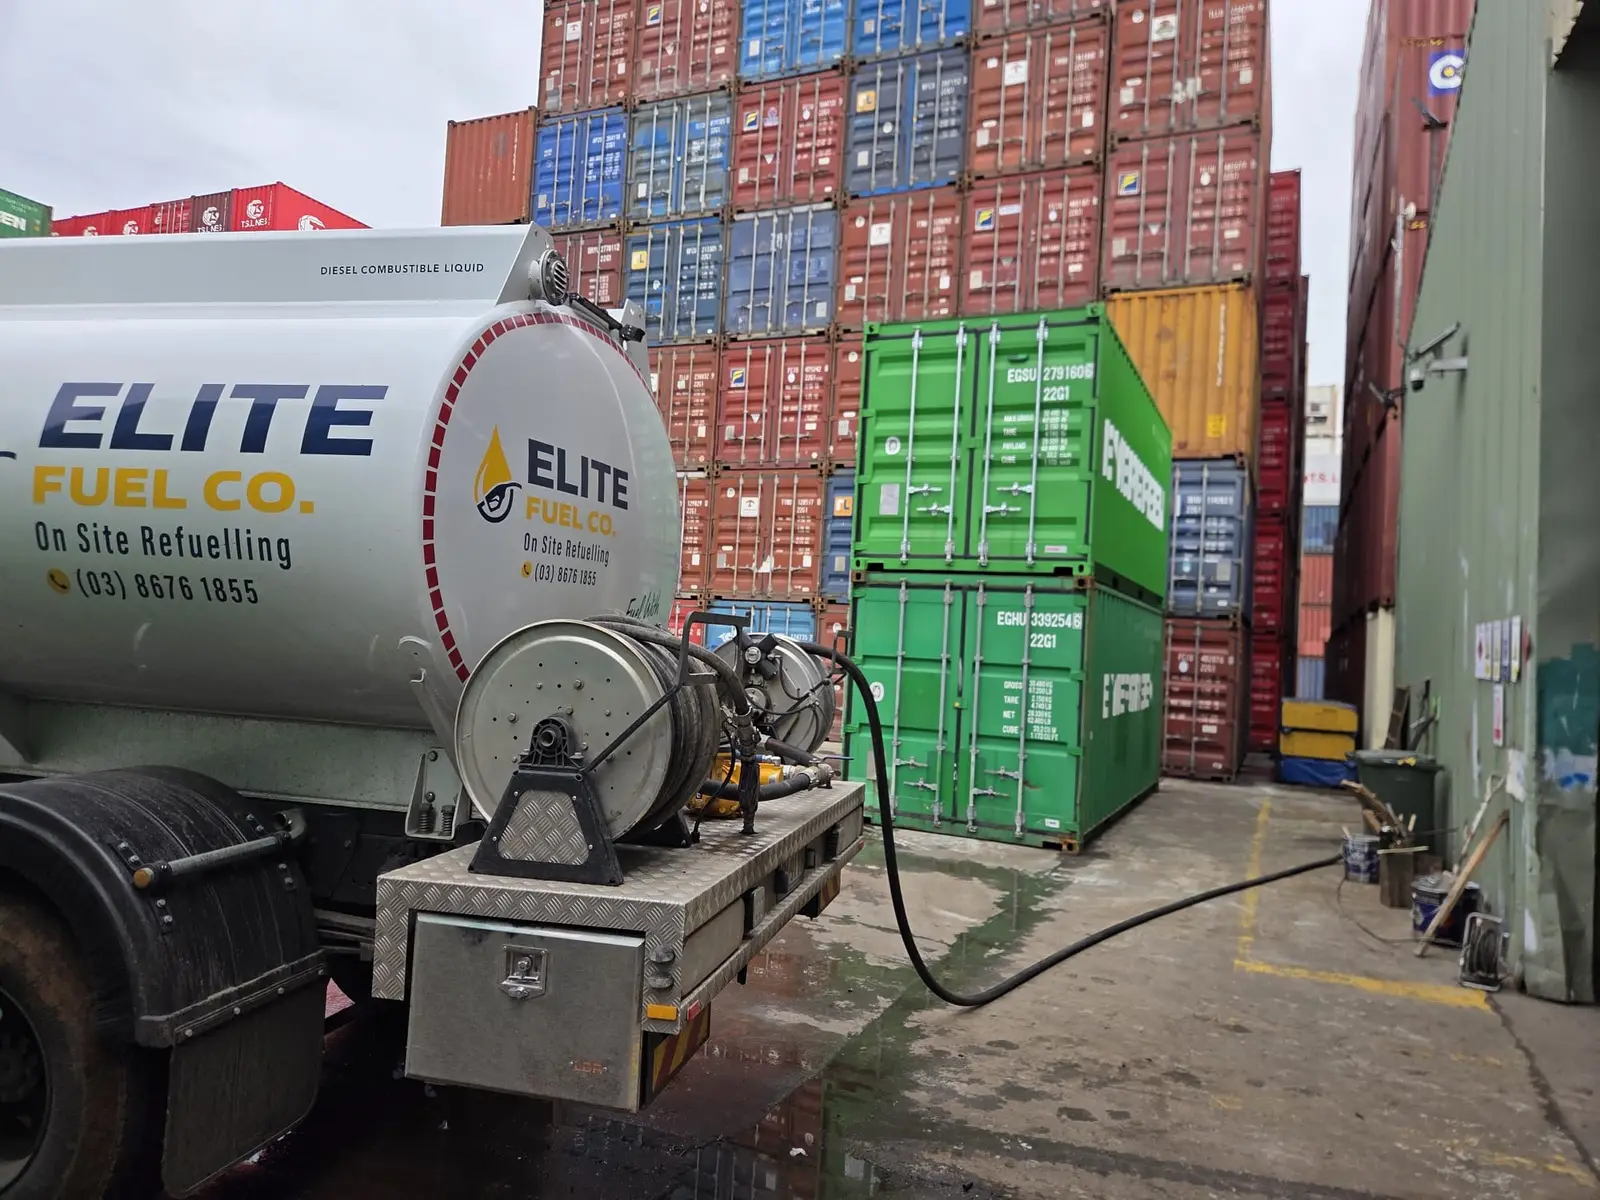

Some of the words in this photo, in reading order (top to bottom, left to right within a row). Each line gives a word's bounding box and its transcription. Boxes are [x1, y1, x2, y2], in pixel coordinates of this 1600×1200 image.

[320, 266, 358, 275] DIESEL
[361, 264, 440, 274] COMBUSTIBLE
[444, 263, 484, 273] LIQUID
[1007, 368, 1037, 383] EGSU
[1042, 386, 1070, 401] 22G1
[39, 382, 389, 457] ELITE
[528, 438, 629, 510] ELITE
[33, 466, 187, 509] FUEL
[203, 471, 315, 514] CO.
[526, 496, 583, 530] FUEL
[588, 511, 616, 536] CO.
[35, 521, 67, 552] On
[78, 523, 129, 555] Site
[141, 526, 292, 570] Refuelling
[524, 533, 537, 552] On
[542, 535, 562, 556] Site
[566, 539, 610, 567] Refuelling
[535, 562, 554, 583] (03)
[558, 566, 578, 584] 8676
[580, 569, 597, 586] 1855
[76, 568, 126, 600] (03)
[135, 574, 193, 601] 8676
[200, 577, 258, 604] 1855
[997, 611, 1026, 626] EGHU
[1031, 612, 1083, 629] 3392546
[1030, 633, 1057, 648] 22G1
[1004, 696, 1019, 704] TARE
[1003, 710, 1015, 719] NET
[1002, 725, 1019, 734] CUBE
